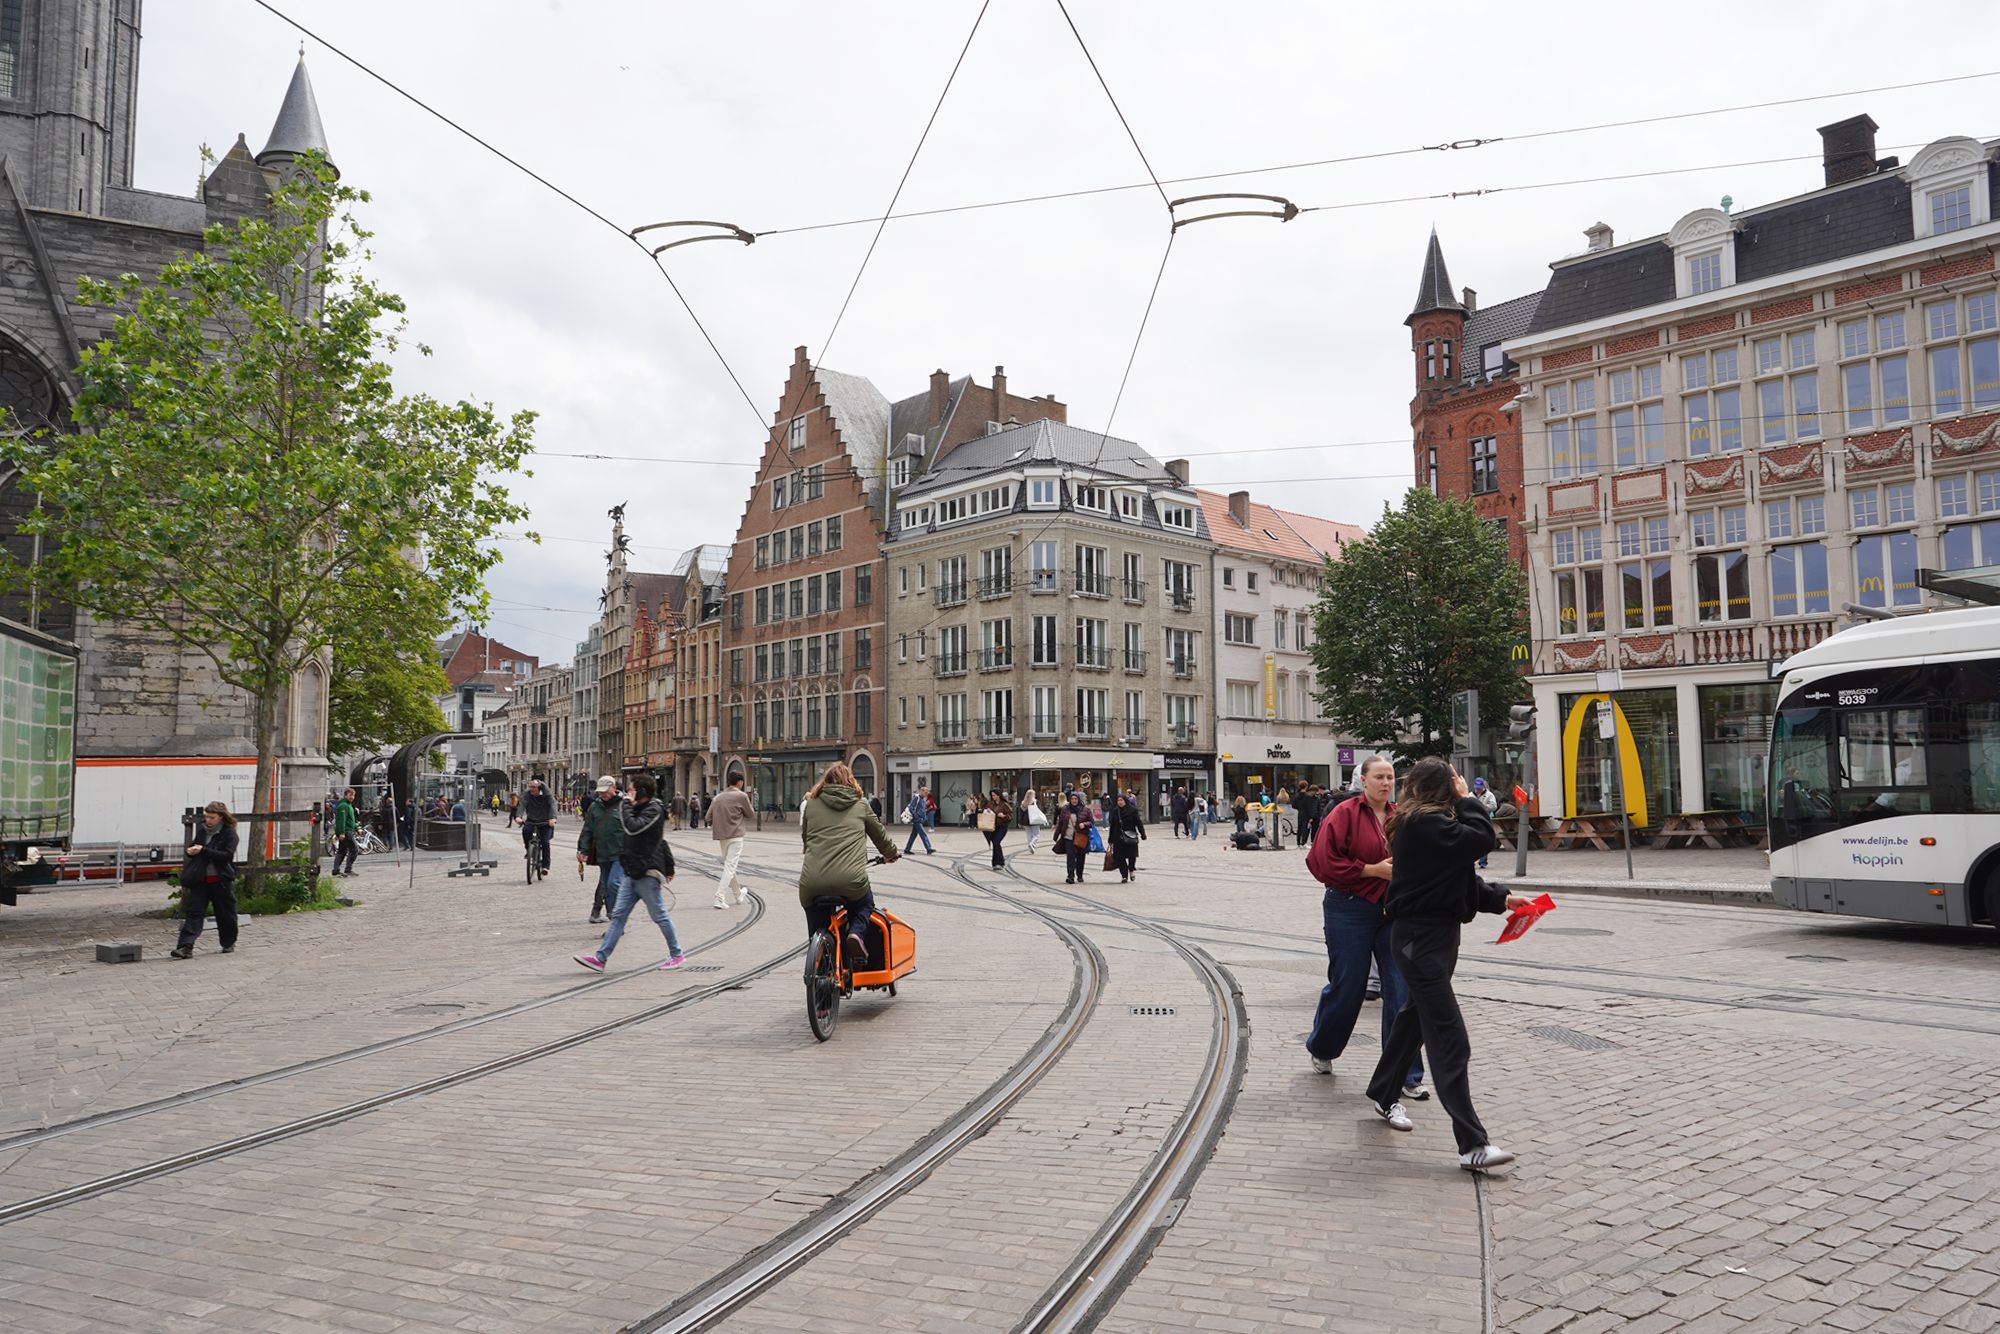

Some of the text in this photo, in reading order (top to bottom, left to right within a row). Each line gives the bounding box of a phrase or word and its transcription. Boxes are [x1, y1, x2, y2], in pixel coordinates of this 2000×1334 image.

[1838, 695, 1867, 705] 5039
[1266, 748, 1292, 759] Panos
[1842, 836, 1909, 847] www.delijn.be
[1852, 852, 1904, 867] Hoppin
